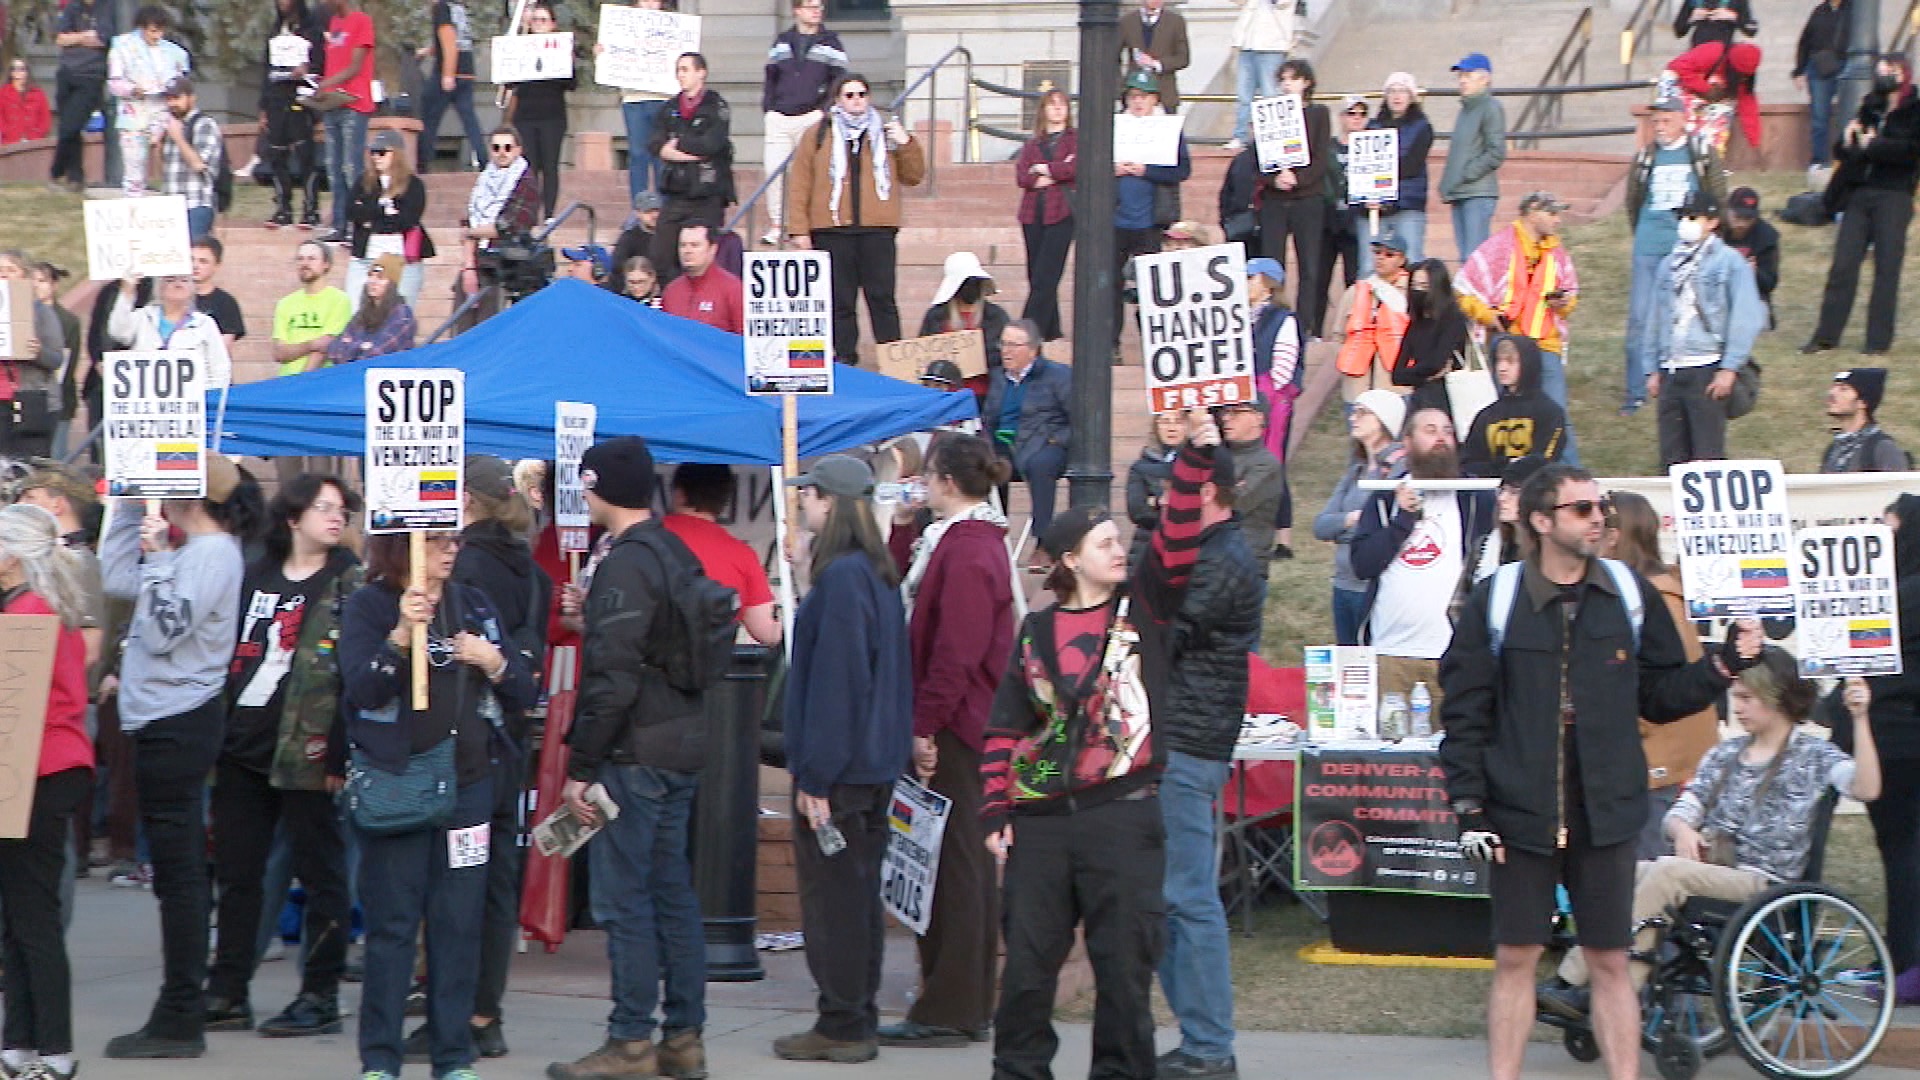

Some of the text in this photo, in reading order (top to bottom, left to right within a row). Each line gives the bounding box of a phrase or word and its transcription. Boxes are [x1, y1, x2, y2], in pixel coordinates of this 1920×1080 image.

[1257, 99, 1295, 122] STOP
[1353, 133, 1392, 154] STOP
[751, 259, 820, 299] STOP
[747, 317, 828, 337] VENEZUELA!
[1148, 303, 1245, 345] HANDS
[1151, 337, 1247, 383] OFF!
[113, 359, 194, 399] STOP
[378, 379, 455, 423] STOP
[107, 419, 201, 439] VENEZUELA!
[372, 445, 461, 467] VENEZUELA!
[1681, 469, 1773, 513] STOP
[1683, 516, 1705, 531] THE
[1681, 532, 1788, 557] VENEZUELA!
[1800, 535, 1883, 579] STOP
[1800, 595, 1893, 619] VENEZUELA!
[885, 868, 923, 923] STOP
